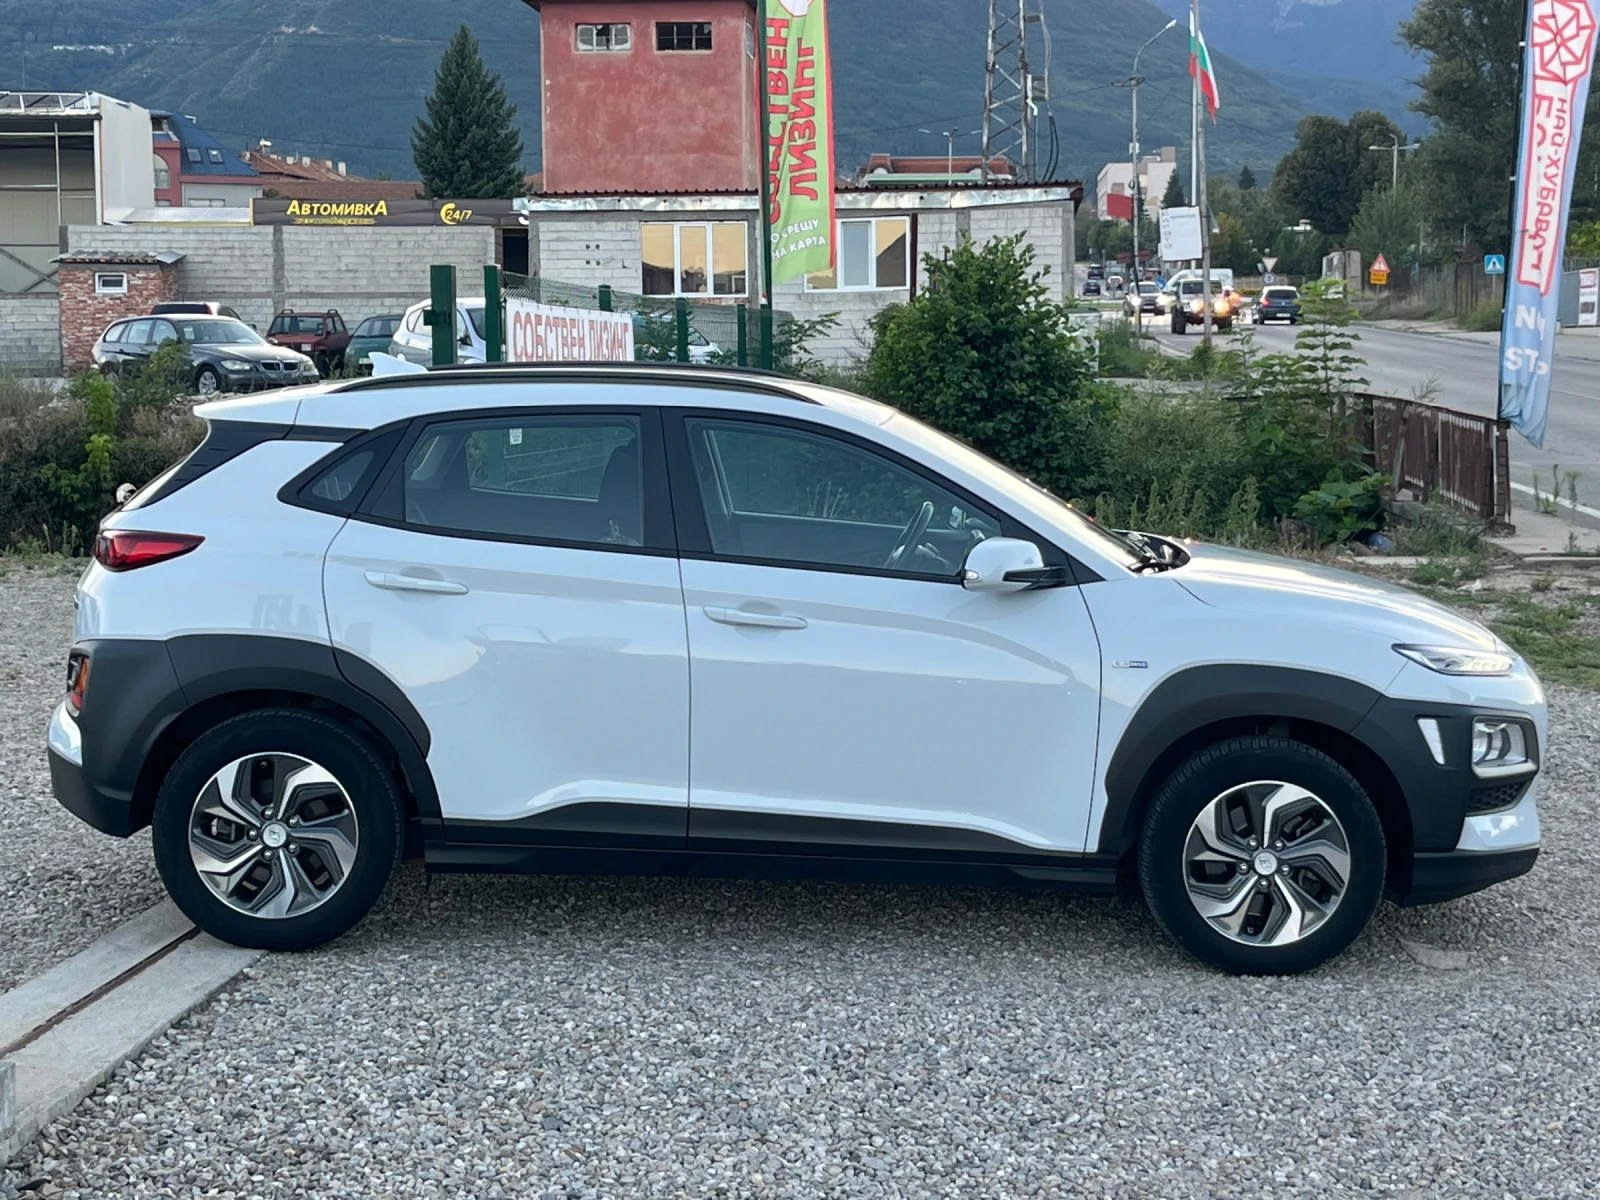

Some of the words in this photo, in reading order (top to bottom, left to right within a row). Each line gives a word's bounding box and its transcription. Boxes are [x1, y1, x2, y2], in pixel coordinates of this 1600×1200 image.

[286, 199, 388, 216] АВТОМИВКА
[446, 209, 472, 222] 24/7
[789, 235, 826, 253] КАРТА
[513, 311, 586, 361] СОБСТВЕН
[588, 319, 629, 361] ЛИЗИНГ
